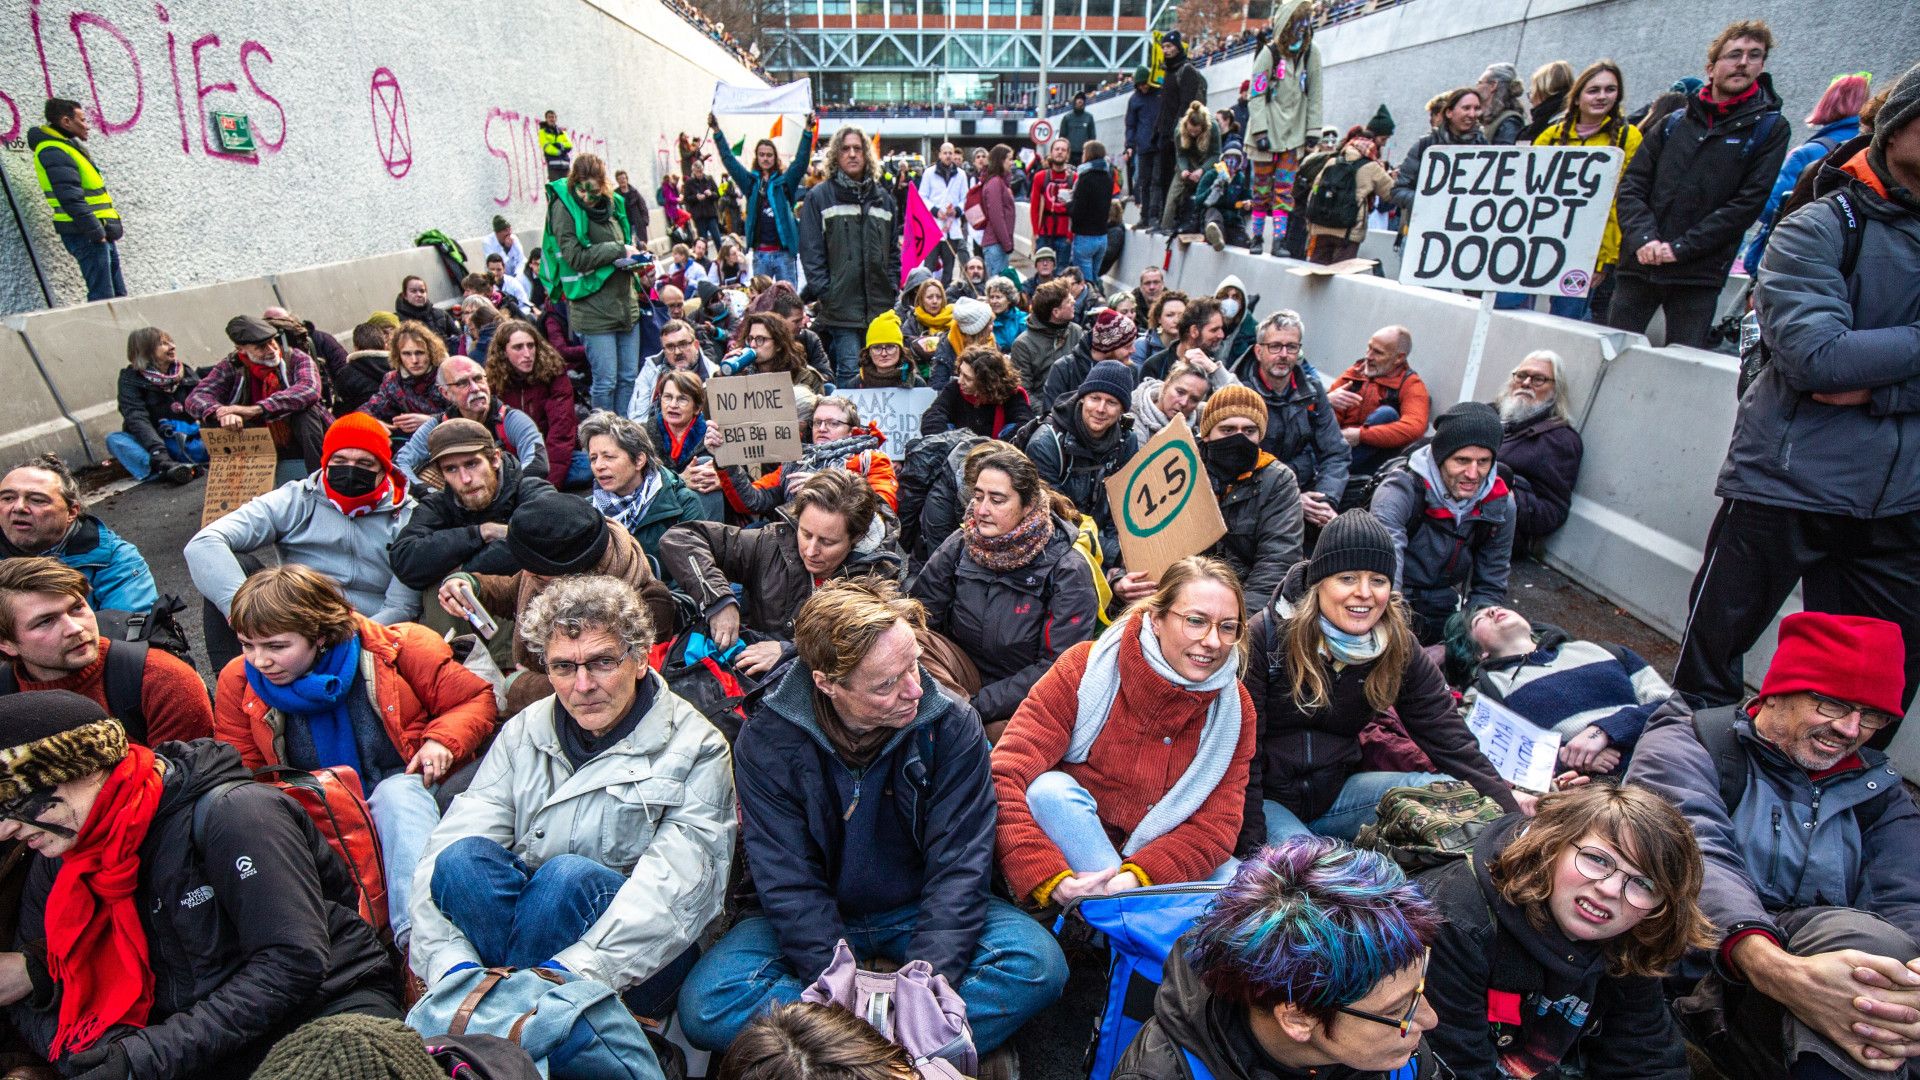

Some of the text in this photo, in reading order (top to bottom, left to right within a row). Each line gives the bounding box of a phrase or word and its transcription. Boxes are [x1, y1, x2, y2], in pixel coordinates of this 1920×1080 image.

[1036, 127, 1049, 137] 70
[1421, 151, 1611, 198] DEZE WEG
[1444, 196, 1588, 239] LOOPT
[1414, 231, 1567, 287] DOOD
[716, 389, 783, 411] NO MORE
[848, 391, 896, 414] AAK
[743, 445, 765, 459] !!!!!
[1137, 455, 1187, 517] 1.5
[180, 892, 204, 906] NORTH
[186, 888, 202, 898] THE
[188, 897, 207, 908] FACE
